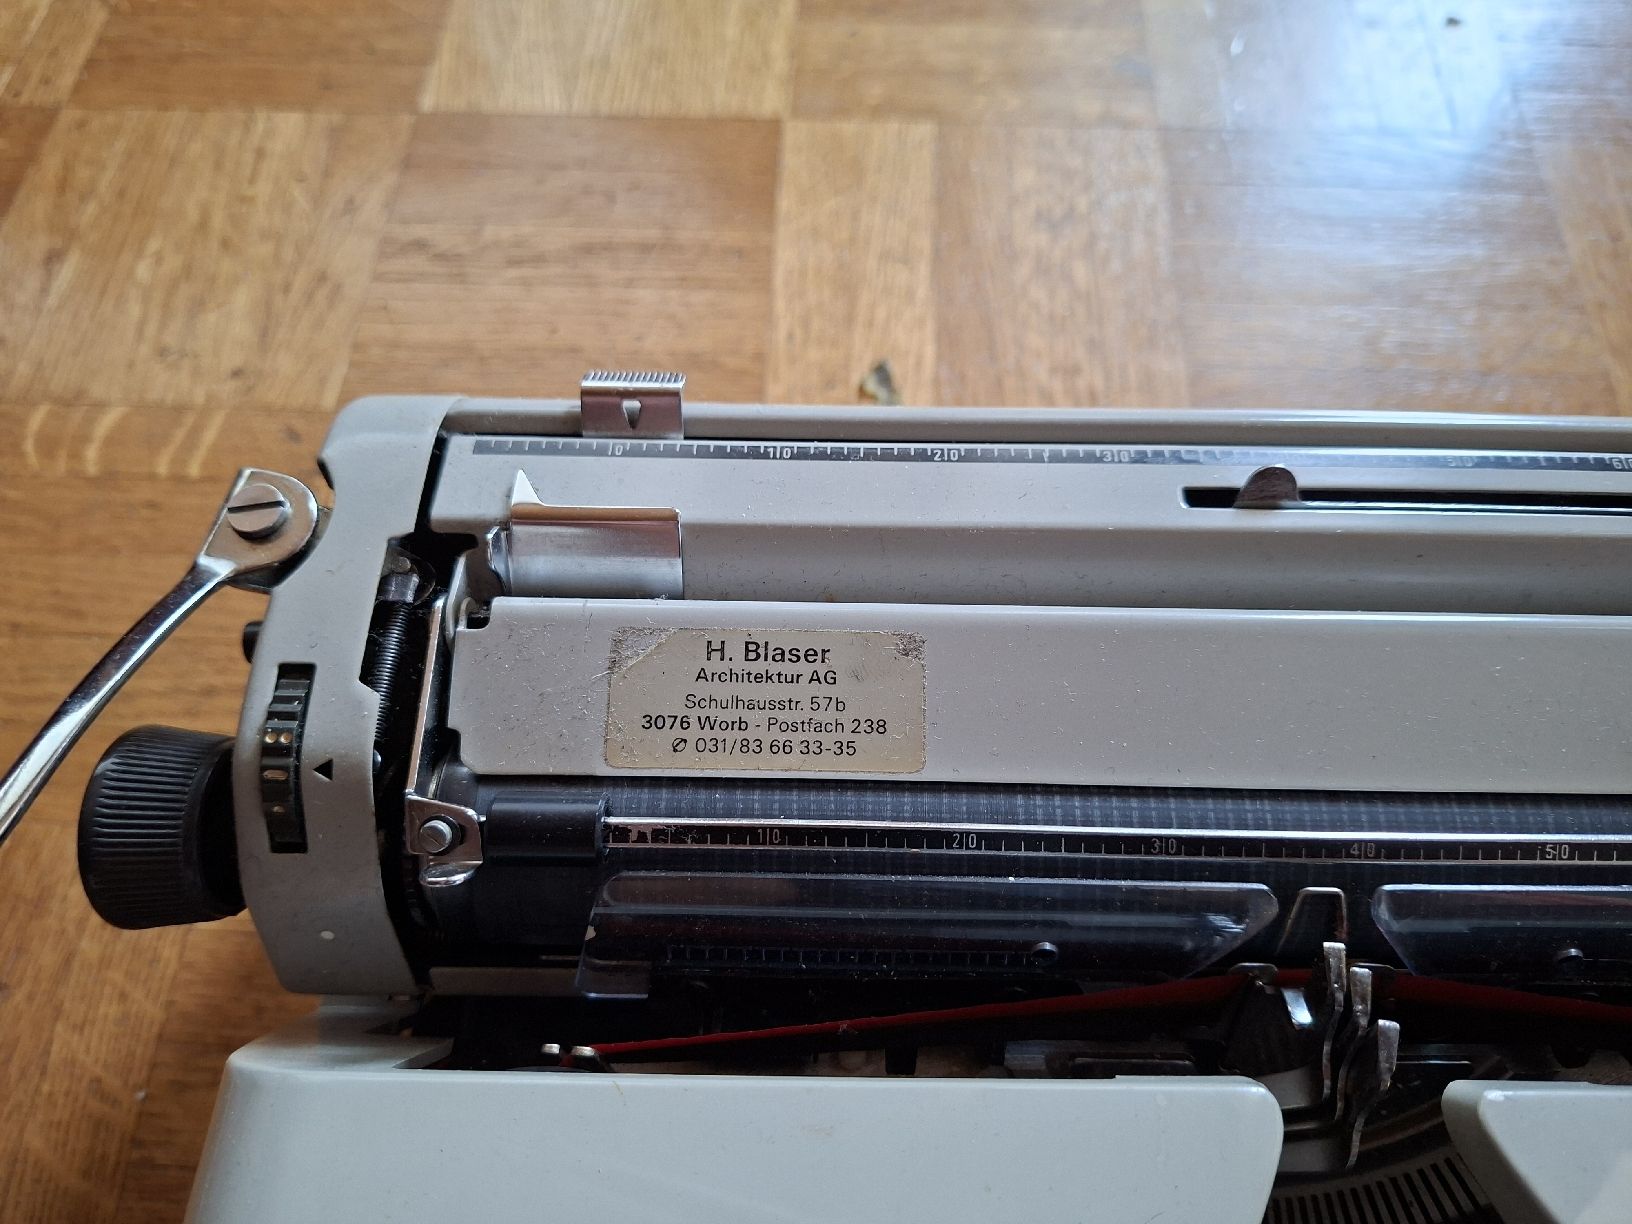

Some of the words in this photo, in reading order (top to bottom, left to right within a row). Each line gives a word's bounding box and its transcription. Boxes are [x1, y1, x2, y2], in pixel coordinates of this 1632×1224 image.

[706, 640, 734, 662] H.
[743, 640, 831, 664] Blaser
[695, 667, 803, 685] Architektur
[807, 670, 838, 686] AG
[684, 693, 805, 712] Schulhausstr.
[809, 696, 847, 712] 57b
[641, 714, 692, 731] 3076
[697, 715, 749, 732] Worb
[767, 716, 845, 734] Postfach
[850, 718, 888, 735] 238
[695, 737, 763, 756] 031/83
[769, 740, 794, 755] 66
[799, 740, 857, 756] 33-35
[952, 833, 977, 849] 20
